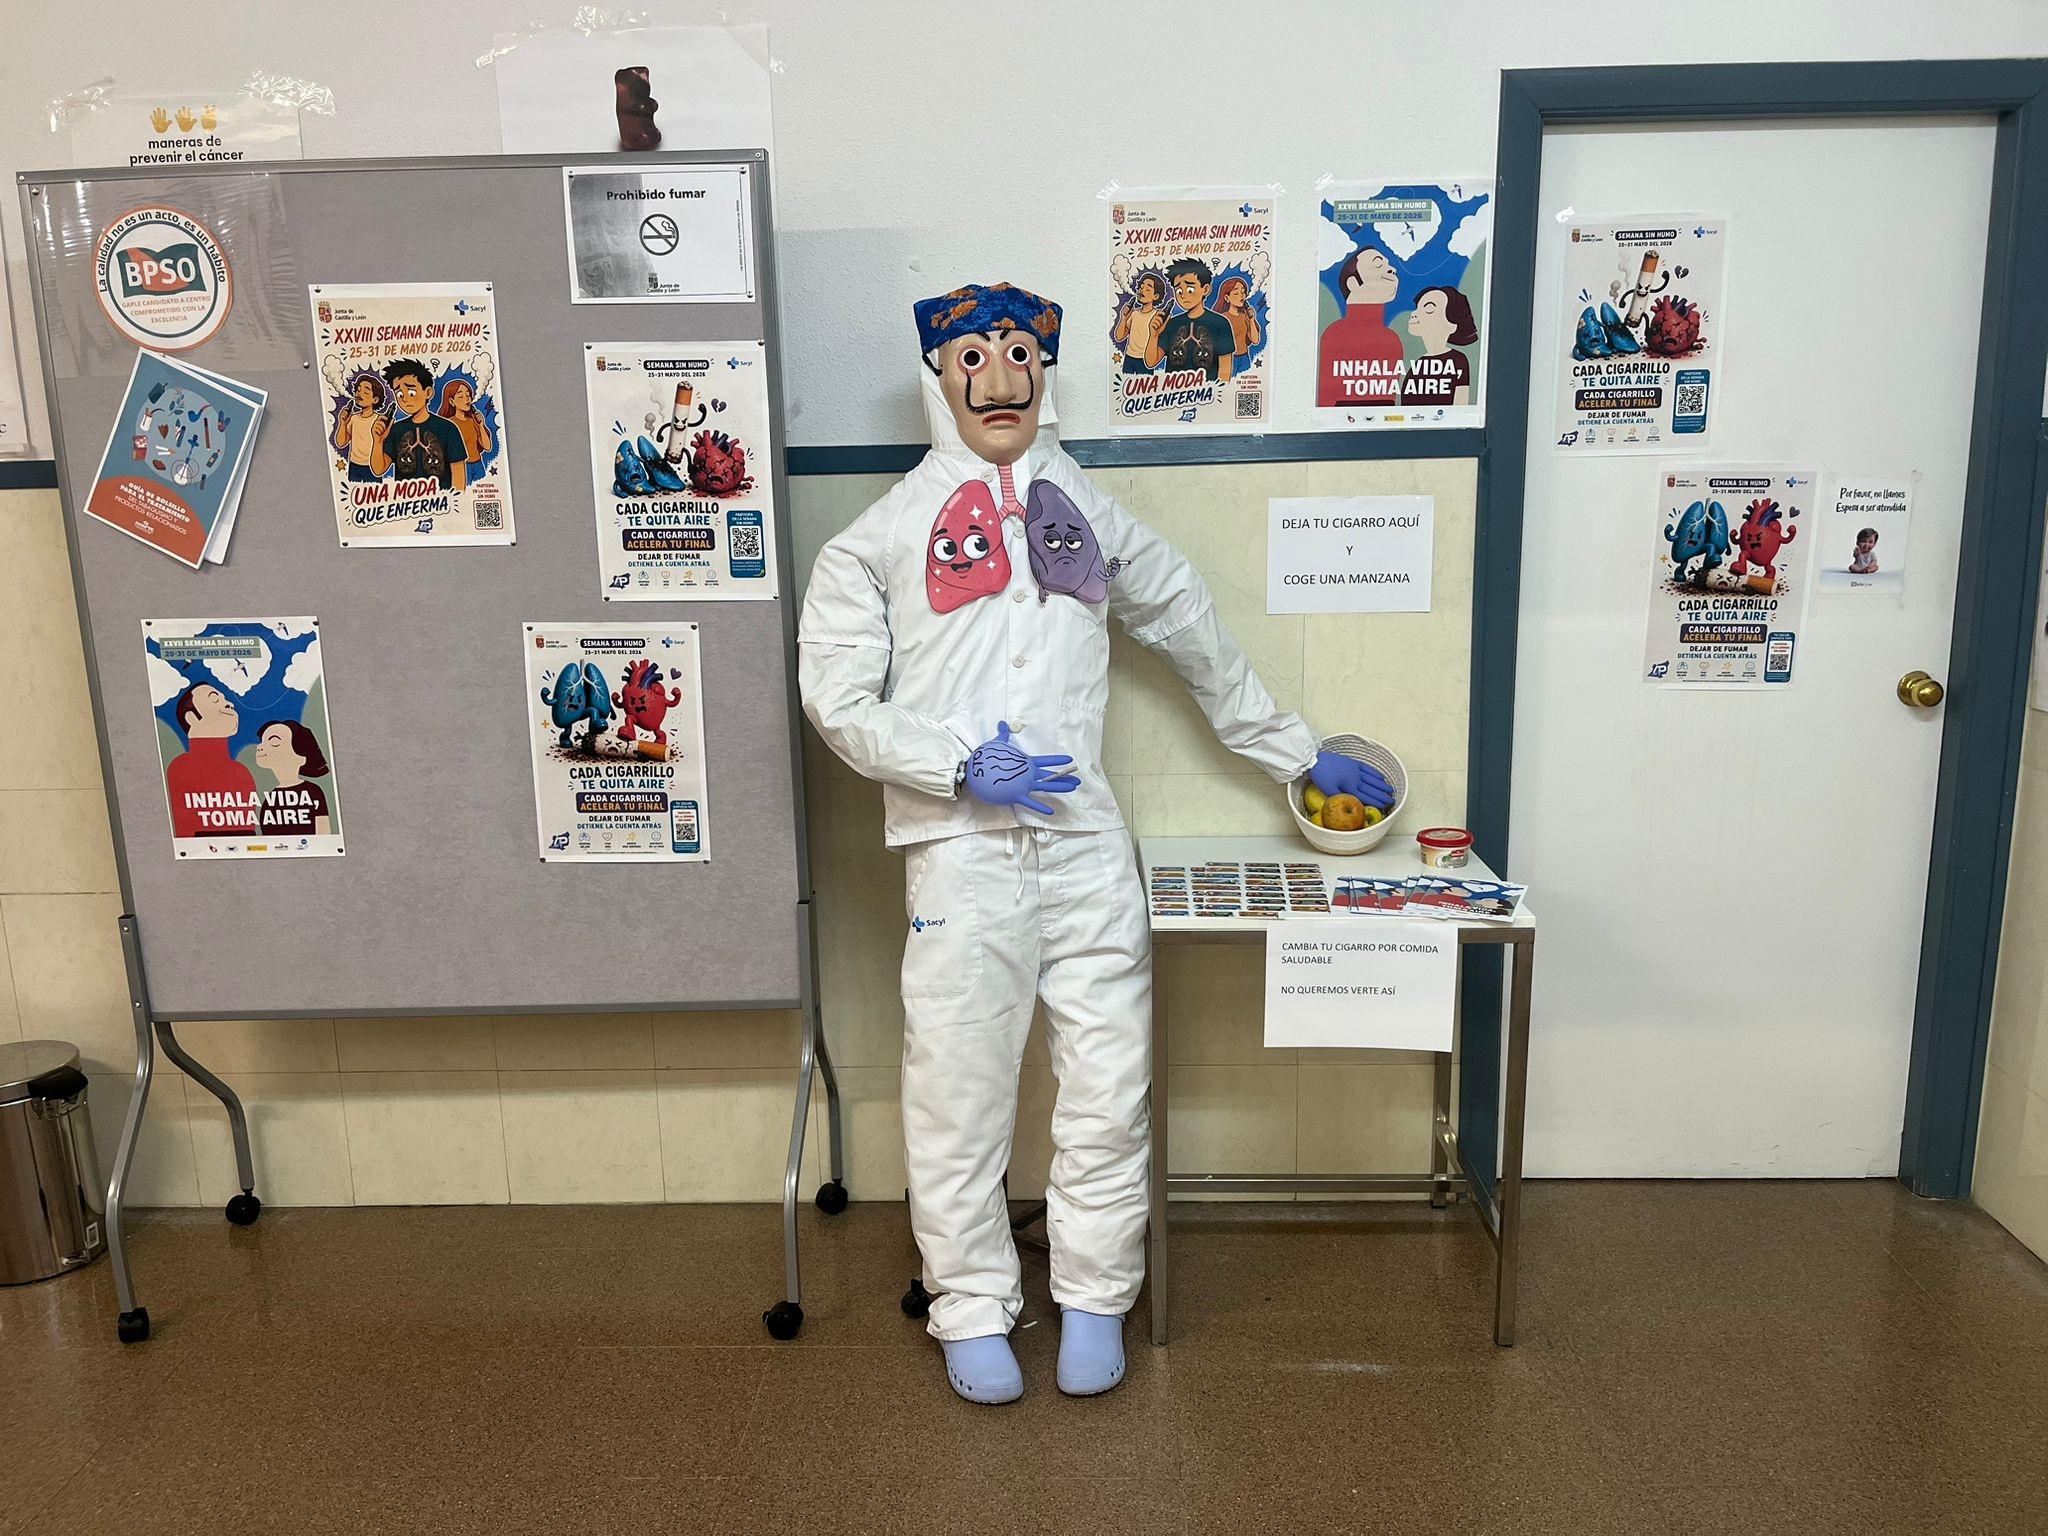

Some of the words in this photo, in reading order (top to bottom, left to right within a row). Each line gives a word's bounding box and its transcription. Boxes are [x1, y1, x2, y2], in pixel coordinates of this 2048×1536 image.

[148, 137, 203, 149] maneras
[206, 135, 222, 147] de
[130, 152, 183, 167] prevenir
[185, 151, 196, 162] el
[199, 149, 244, 162] cáncer
[606, 189, 666, 200] Prohibido
[669, 188, 706, 200] fumar
[1337, 202, 1358, 210] XXVII
[1358, 202, 1390, 210] SEMANA
[124, 215, 136, 227] es
[138, 210, 152, 221] un
[155, 210, 182, 227] acto,
[111, 223, 124, 238] no
[183, 218, 196, 231] es
[196, 227, 210, 244] un
[1124, 228, 1162, 245] XXVIII
[1164, 226, 1206, 242] SEMANA
[1209, 225, 1228, 239] SIN
[1230, 224, 1262, 238] HUMO
[98, 235, 114, 276] calidad
[1137, 246, 1166, 258] 25-31
[1170, 244, 1182, 256] DE
[1185, 243, 1211, 254] MAYO
[1213, 242, 1226, 252] DE
[1227, 240, 1251, 252] 2026
[208, 244, 226, 283] hábito
[124, 256, 196, 287] BPSO
[100, 278, 108, 293] La
[142, 298, 178, 307] CANDIDATO
[470, 304, 486, 313] Sacyl
[130, 307, 182, 317] COMPROMETIDO
[196, 304, 206, 312] LA
[151, 315, 188, 324] EXCELENCIA
[334, 327, 374, 345] XXVIII
[376, 324, 422, 341] SEMANA
[425, 324, 446, 339] SIN
[448, 322, 481, 338] HUMO
[350, 346, 380, 359] 25-31
[384, 345, 398, 356] DE
[400, 343, 428, 355] MAYO
[430, 342, 444, 354] DE
[446, 340, 472, 352] 2026
[646, 361, 674, 369] SEMANA
[675, 361, 687, 369] SIN
[1332, 360, 1406, 377] INHALA
[1409, 359, 1462, 379] VIDA,
[1572, 364, 1604, 377] CADA
[1607, 362, 1670, 376] CIGARRILLO
[1125, 376, 1159, 396] UNA
[1162, 369, 1204, 388] MODA
[1342, 380, 1402, 396] TOMA
[1404, 379, 1452, 395] AIRE
[1582, 378, 1595, 388] TE
[1600, 376, 1632, 387] QUITA
[1635, 375, 1661, 386] AIRE
[1124, 396, 1152, 414] QUE
[1153, 387, 1214, 409] ENFERMA
[128, 482, 145, 494] GUÍA
[146, 490, 155, 498] DE
[156, 496, 186, 514] BOLSILLO
[354, 486, 389, 506] UNA
[393, 478, 438, 499] MODA
[1840, 487, 1852, 500] Por
[1853, 488, 1873, 500] favor,
[1883, 489, 1906, 499] llames
[120, 484, 137, 497] PARA
[146, 498, 190, 522] TRATAMIENTO
[616, 502, 648, 516] CADA
[651, 501, 720, 515] CIGARRILLO
[1836, 502, 1860, 514] Espera
[1866, 504, 1876, 512] ser
[1876, 502, 1906, 512] atendida
[355, 506, 385, 524] QUE
[386, 496, 449, 519] ENFERMA
[627, 516, 642, 527] TE
[646, 516, 681, 526] QUITA
[684, 516, 710, 526] AIRE
[1282, 518, 1310, 529] DEJA
[1314, 518, 1329, 528] TU
[1332, 517, 1386, 528] CIGARRO
[1388, 514, 1420, 529] AQUÍ
[630, 531, 654, 540] CADA
[656, 530, 707, 539] CIGARRILLO
[627, 540, 668, 550] ACELERA
[670, 540, 682, 549] TU
[684, 540, 711, 549] FINAL
[1346, 545, 1354, 556] Y
[1284, 574, 1316, 585] COGE
[1319, 574, 1346, 585] UNA
[1348, 573, 1410, 584] MANZANA
[1678, 600, 1709, 612] CADA
[1712, 599, 1778, 611] CIGARRILLO
[1688, 612, 1702, 622] TE
[1705, 611, 1739, 622] QUITA
[1742, 611, 1768, 620] AIRE
[231, 638, 255, 646] HUMO
[165, 650, 185, 658] 25-31
[570, 767, 602, 780] CADA
[606, 766, 674, 779] CIGARRILLO
[581, 780, 596, 790] TE
[599, 780, 635, 790] QUITA
[638, 780, 665, 789] AIRE
[184, 791, 262, 809] INHALA
[262, 790, 320, 810] VIDA,
[197, 810, 260, 827] TOMA
[263, 809, 312, 826] AIRE
[926, 918, 946, 926] Sacyl
[1282, 942, 1318, 951] CAMBIA
[1320, 943, 1332, 951] TU
[1334, 943, 1376, 952] CIGARRO
[1378, 944, 1396, 952] POR
[1399, 944, 1438, 954] COMIDA
[1281, 956, 1332, 964] SALUDABLE
[1281, 986, 1295, 994] NO
[1297, 986, 1349, 995] QUEREMOS
[1350, 986, 1379, 995] VERTE
[1381, 986, 1397, 996] ASÍ
